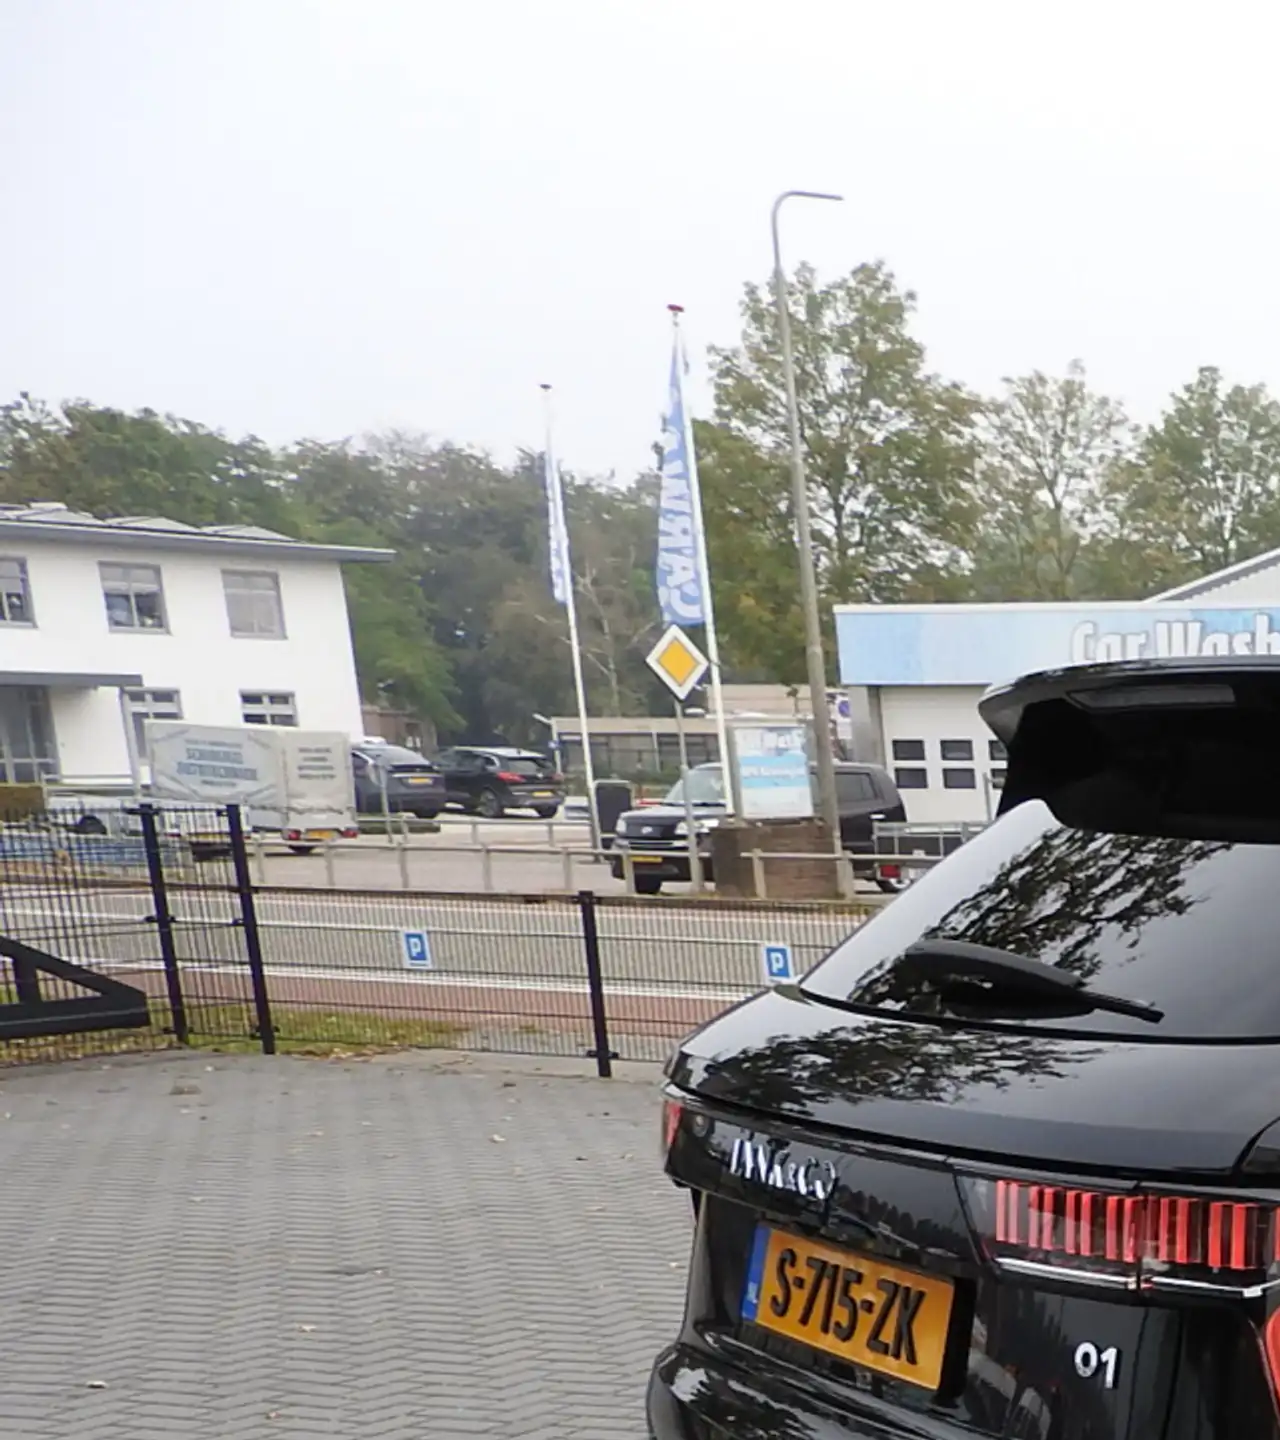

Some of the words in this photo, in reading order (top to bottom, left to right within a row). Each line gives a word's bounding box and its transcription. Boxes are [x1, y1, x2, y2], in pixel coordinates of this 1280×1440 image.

[1071, 620, 1147, 662] Car
[769, 1247, 928, 1366] S-715-ZK
[1074, 1341, 1118, 1390] 01
